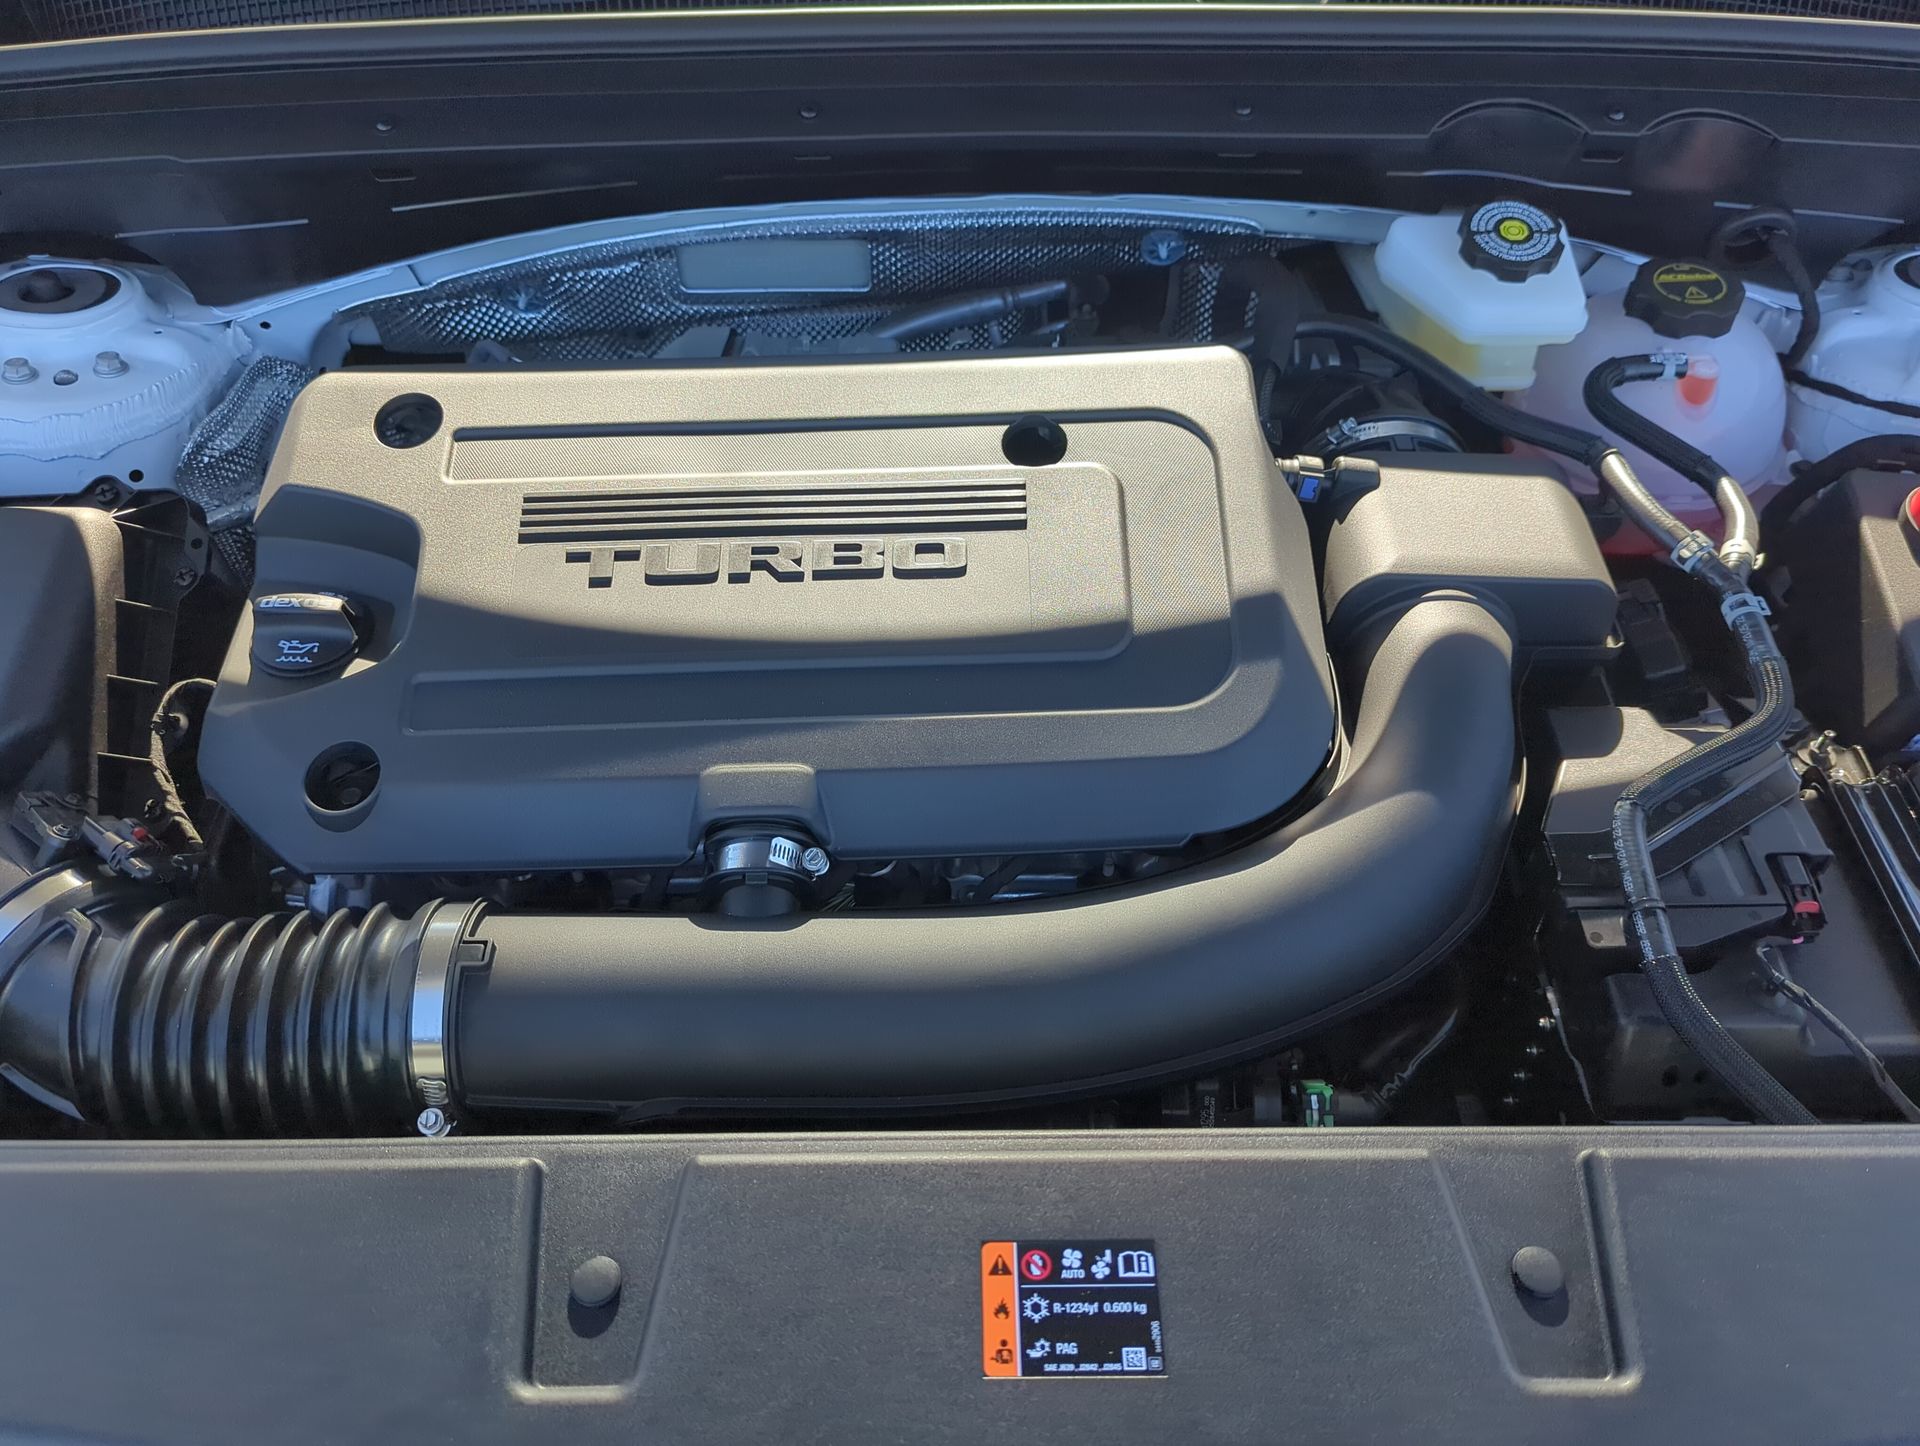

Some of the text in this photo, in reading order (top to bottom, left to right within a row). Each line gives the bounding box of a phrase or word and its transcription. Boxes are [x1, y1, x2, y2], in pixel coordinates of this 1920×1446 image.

[565, 537, 967, 589] TURBO
[259, 596, 333, 609] dexos
[1061, 1269, 1086, 1279] AUTO
[1053, 1301, 1148, 1315] R-1234yf 0.600 kg
[1056, 1343, 1078, 1355] PAG
